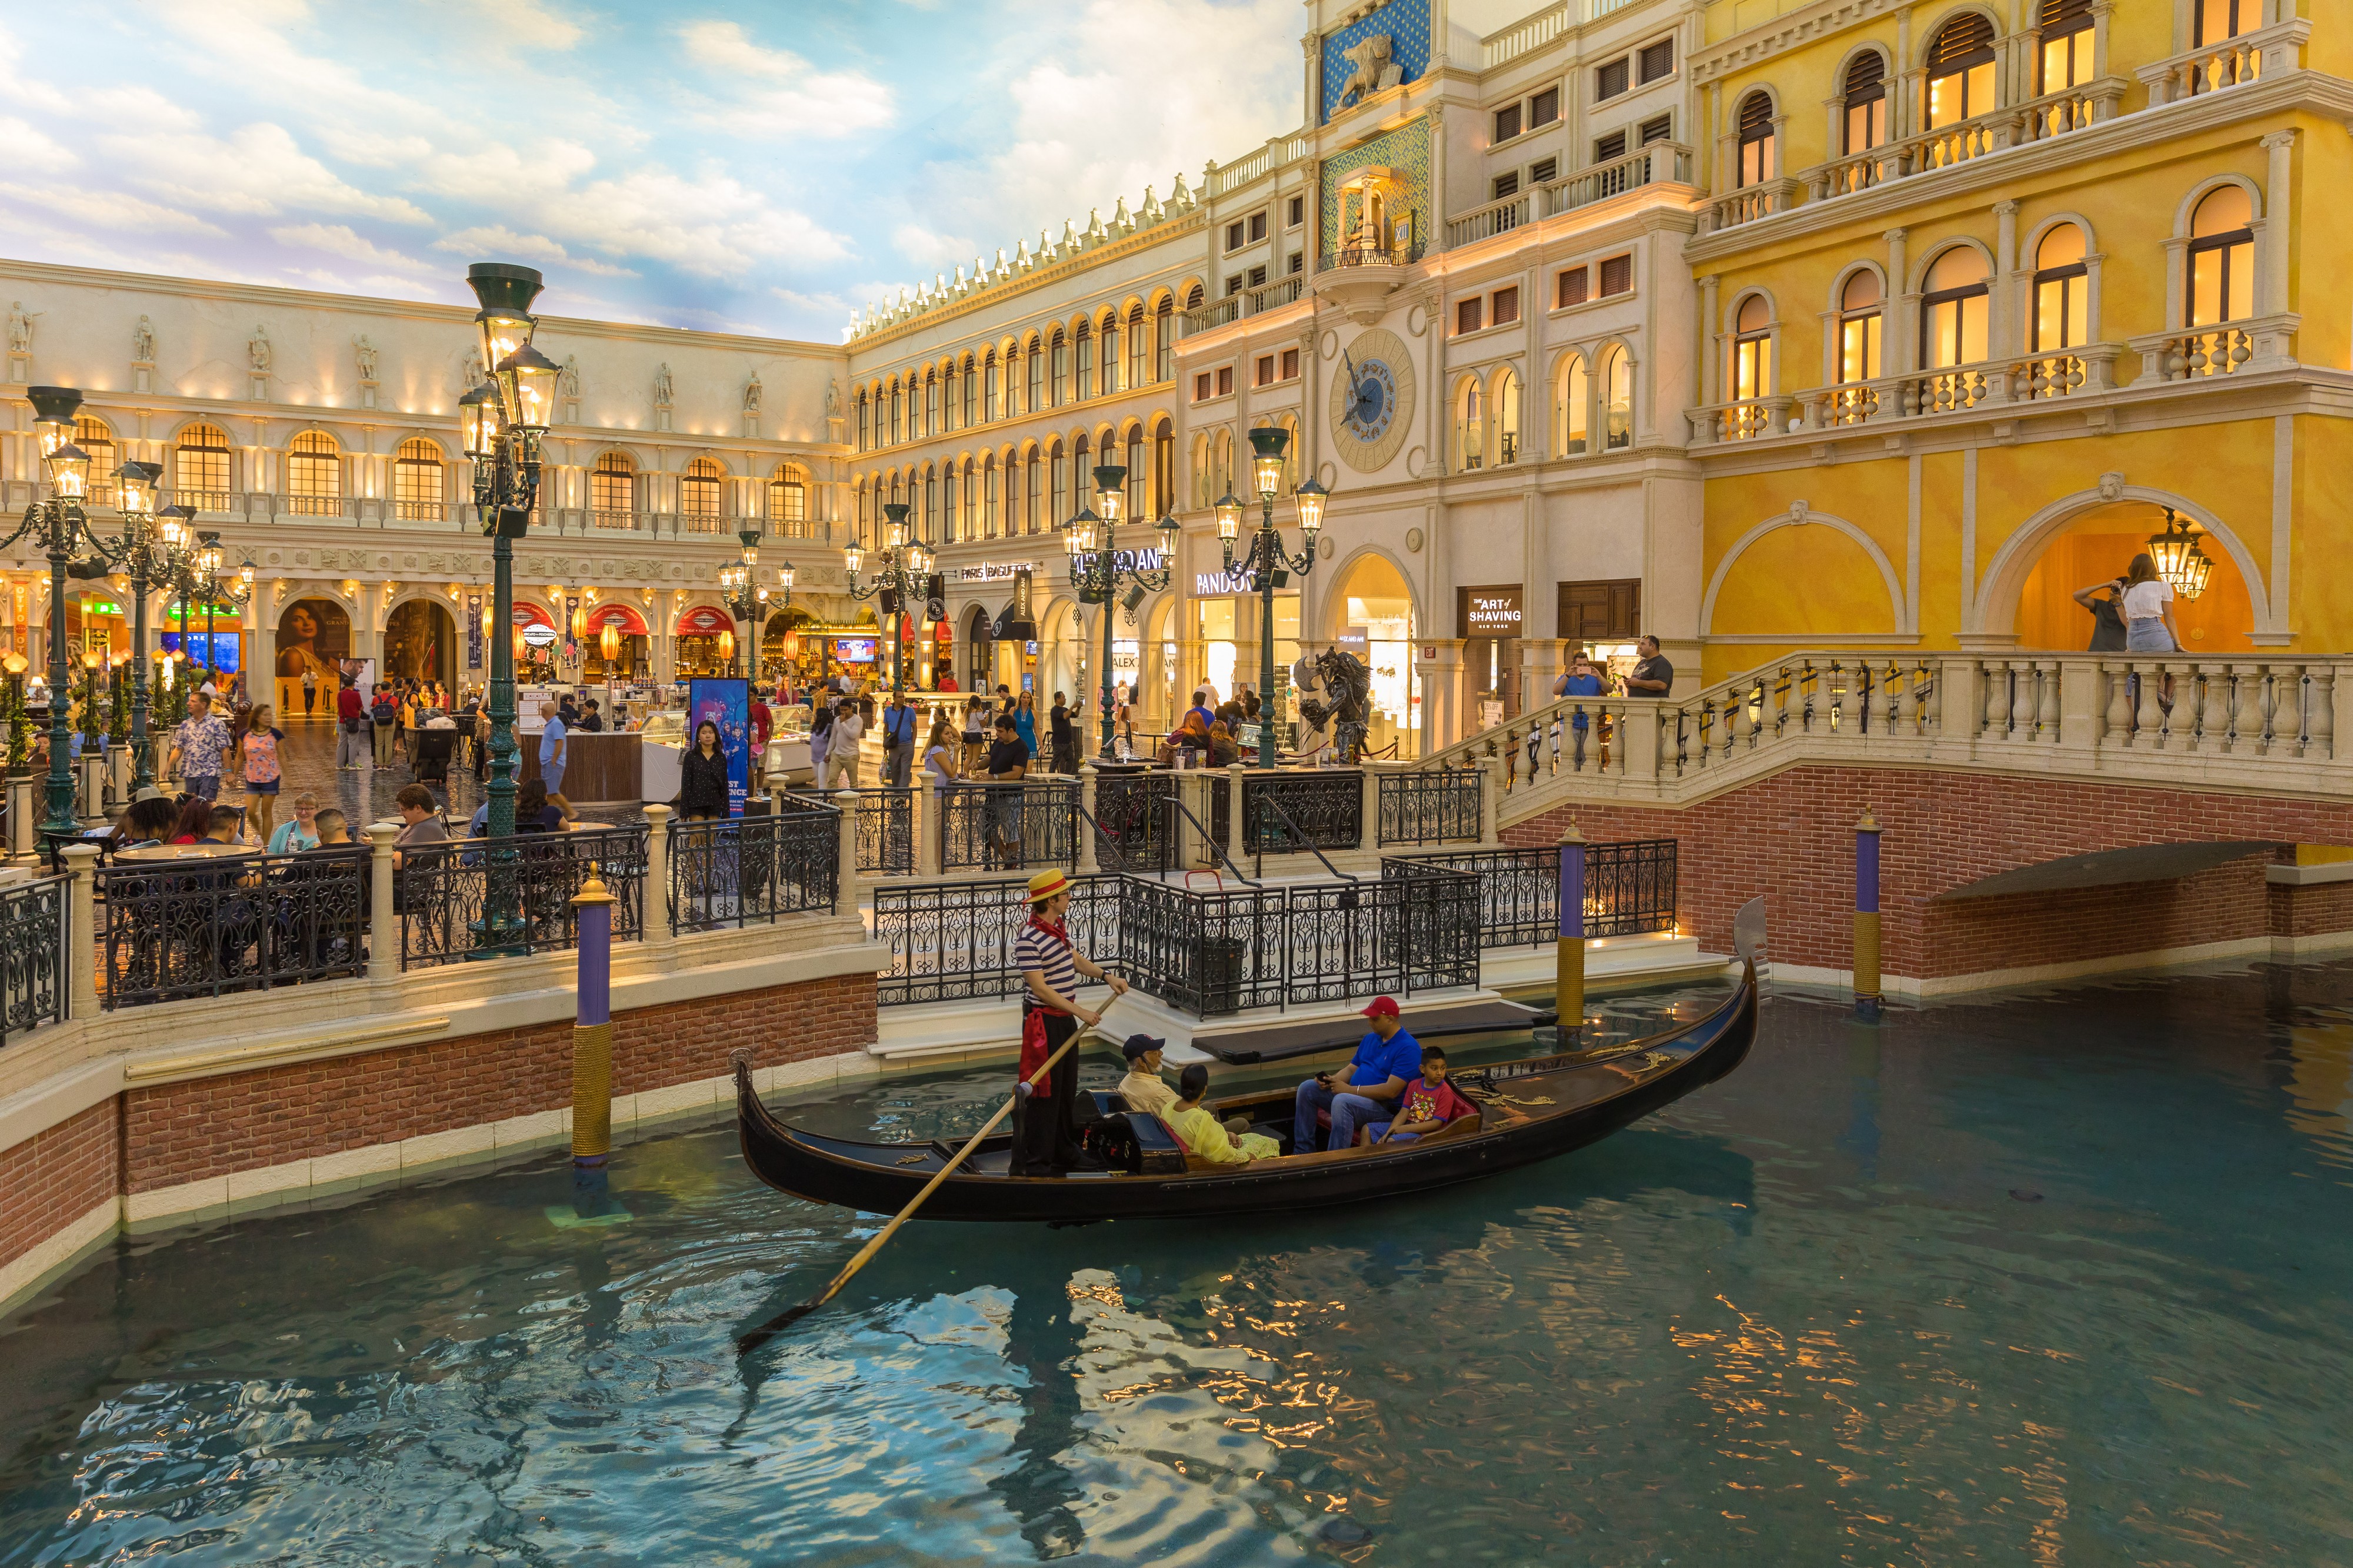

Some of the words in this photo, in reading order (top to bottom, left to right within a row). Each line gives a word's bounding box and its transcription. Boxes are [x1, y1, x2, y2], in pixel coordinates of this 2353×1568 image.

[1395, 225, 1407, 242] XII
[1136, 548, 1162, 571] ANI
[962, 568, 984, 579] PARIS
[1197, 570, 1257, 595] PANDOR
[16, 586, 25, 623] OTTO
[1480, 599, 1504, 610] ART
[1504, 598, 1512, 609] of
[625, 609, 639, 620] MARKET
[715, 611, 726, 621] MARKET
[1469, 610, 1521, 622] SHAVING
[1426, 648, 1434, 658] EXIT
[1113, 658, 1135, 668] ALEX
